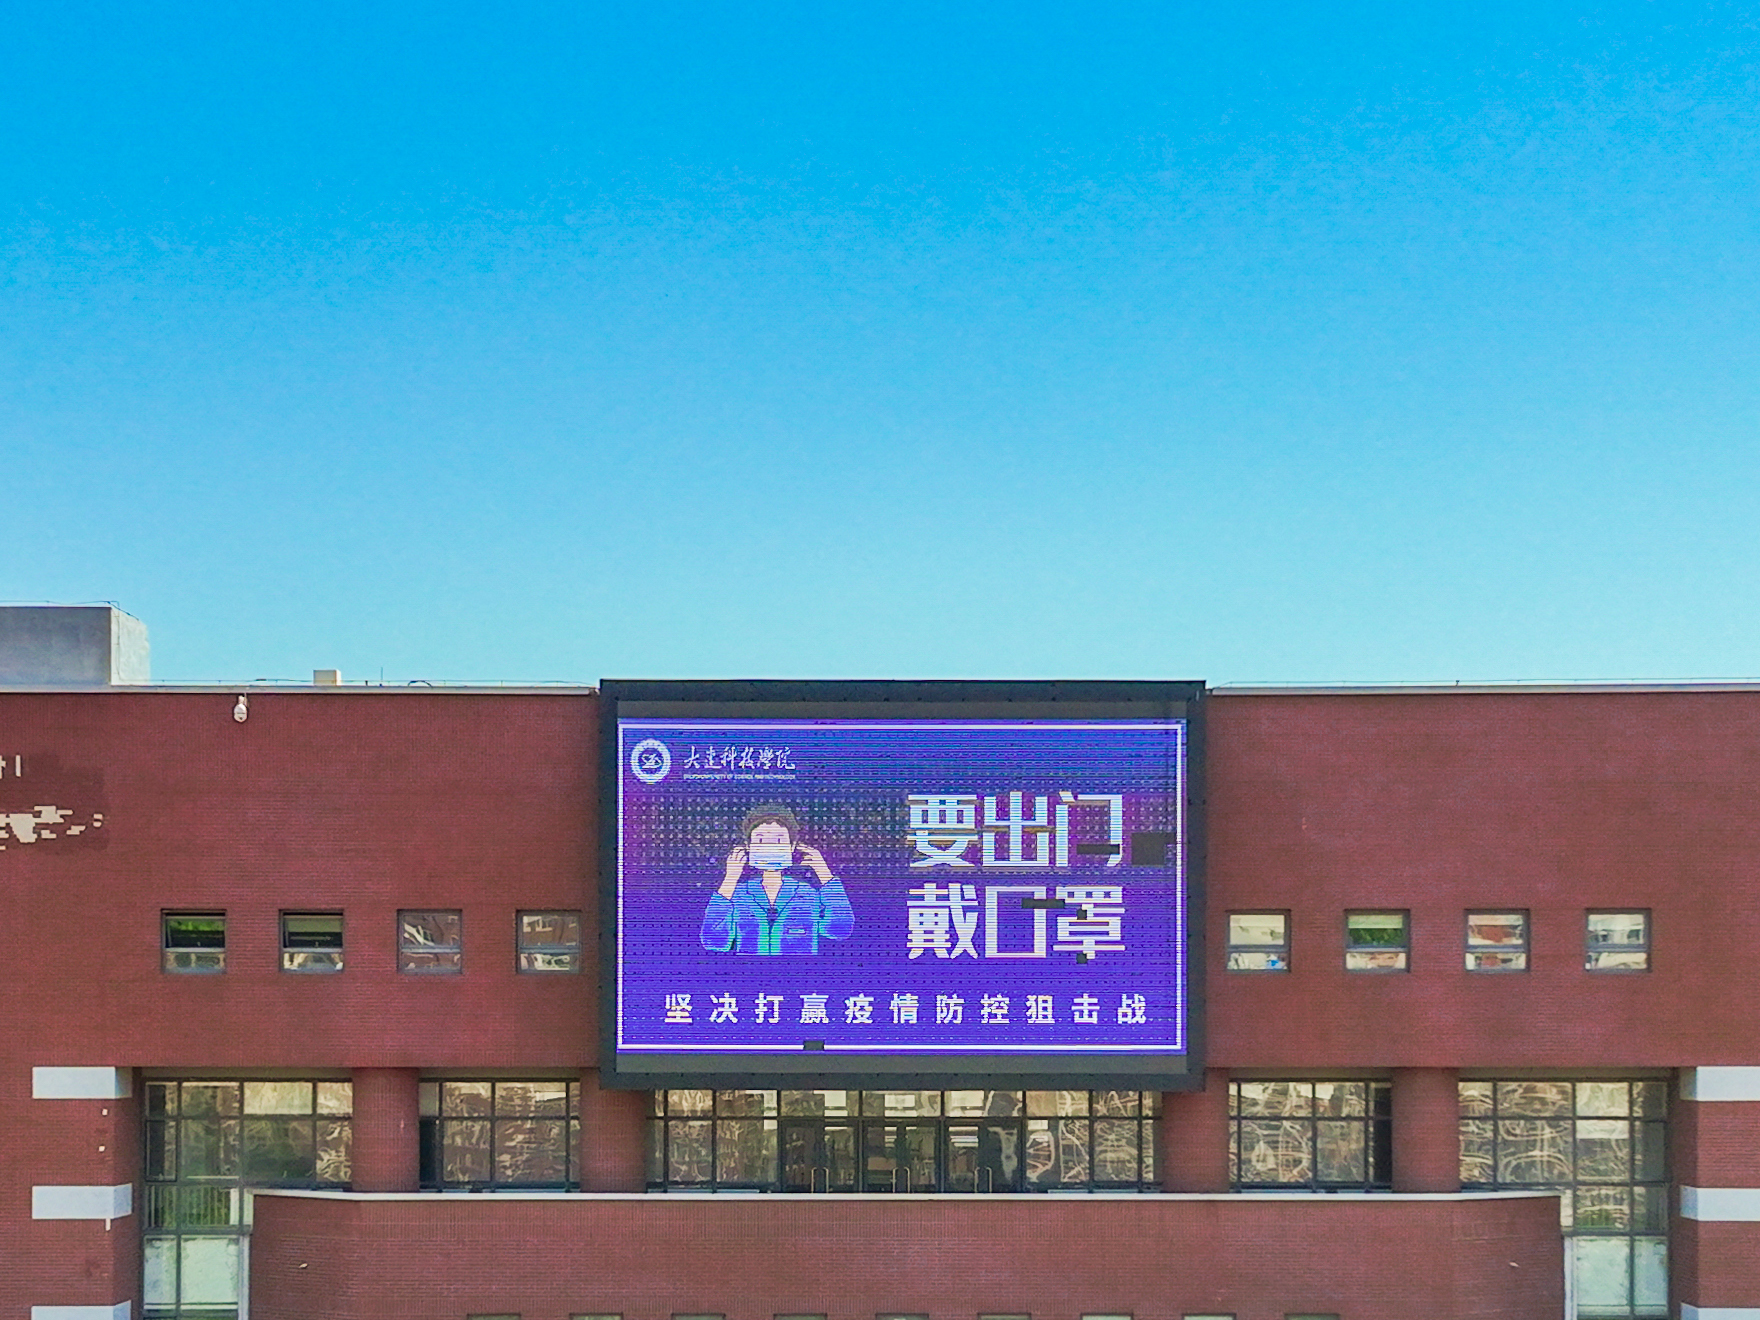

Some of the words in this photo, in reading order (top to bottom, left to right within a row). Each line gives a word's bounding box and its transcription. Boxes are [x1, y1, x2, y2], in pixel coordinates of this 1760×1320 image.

[907, 791, 1124, 868] 要出门
[906, 883, 1126, 960] 戴口罩
[664, 992, 1147, 1025] 坚决打赢疫情防控狙击战
